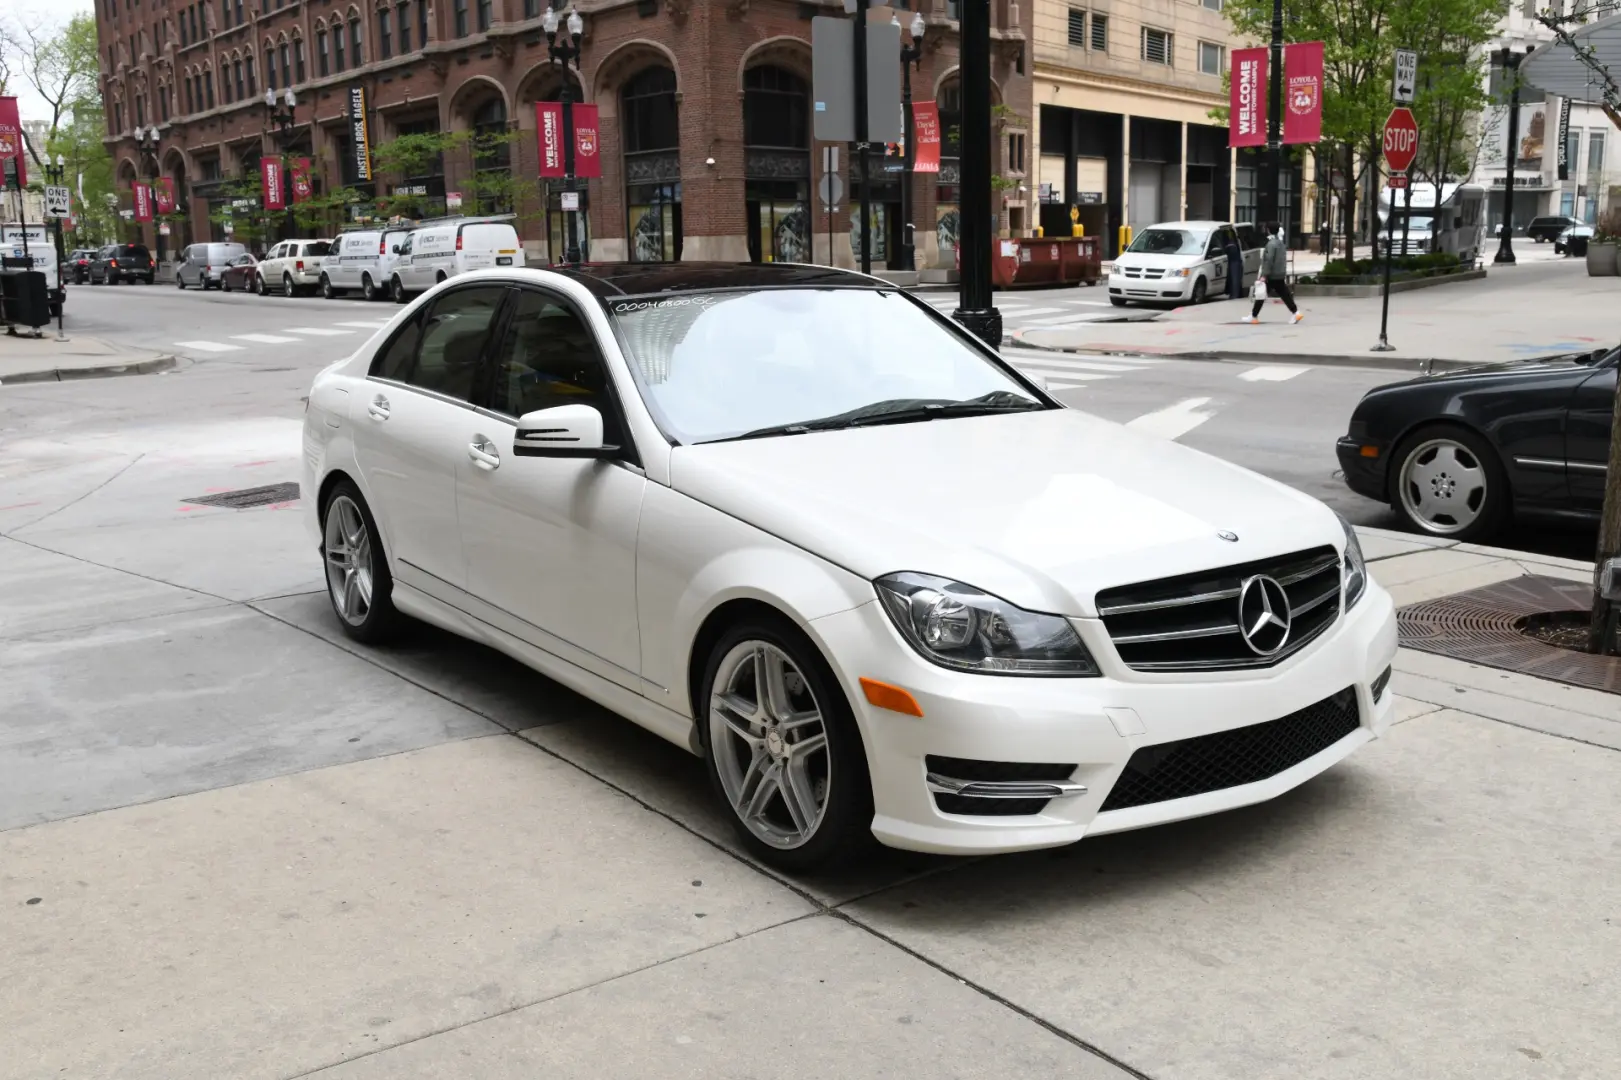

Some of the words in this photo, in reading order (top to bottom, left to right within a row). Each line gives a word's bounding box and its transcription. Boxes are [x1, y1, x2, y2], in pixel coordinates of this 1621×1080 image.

[1397, 68, 1414, 82] WAY
[1398, 54, 1415, 69] ONE
[1289, 76, 1317, 84] LOYOLA
[352, 88, 363, 119] BAGELS
[1239, 60, 1251, 135] WELCOME
[1559, 98, 1570, 143] ORDSTROM
[544, 111, 554, 168] WELCOME
[1385, 128, 1416, 152] STOP
[356, 143, 368, 179] EINSTEIN
[48, 188, 68, 198] ONE
[267, 164, 276, 203] WELCOME
[48, 197, 68, 206] WAY
[137, 186, 145, 216] WELCOME
